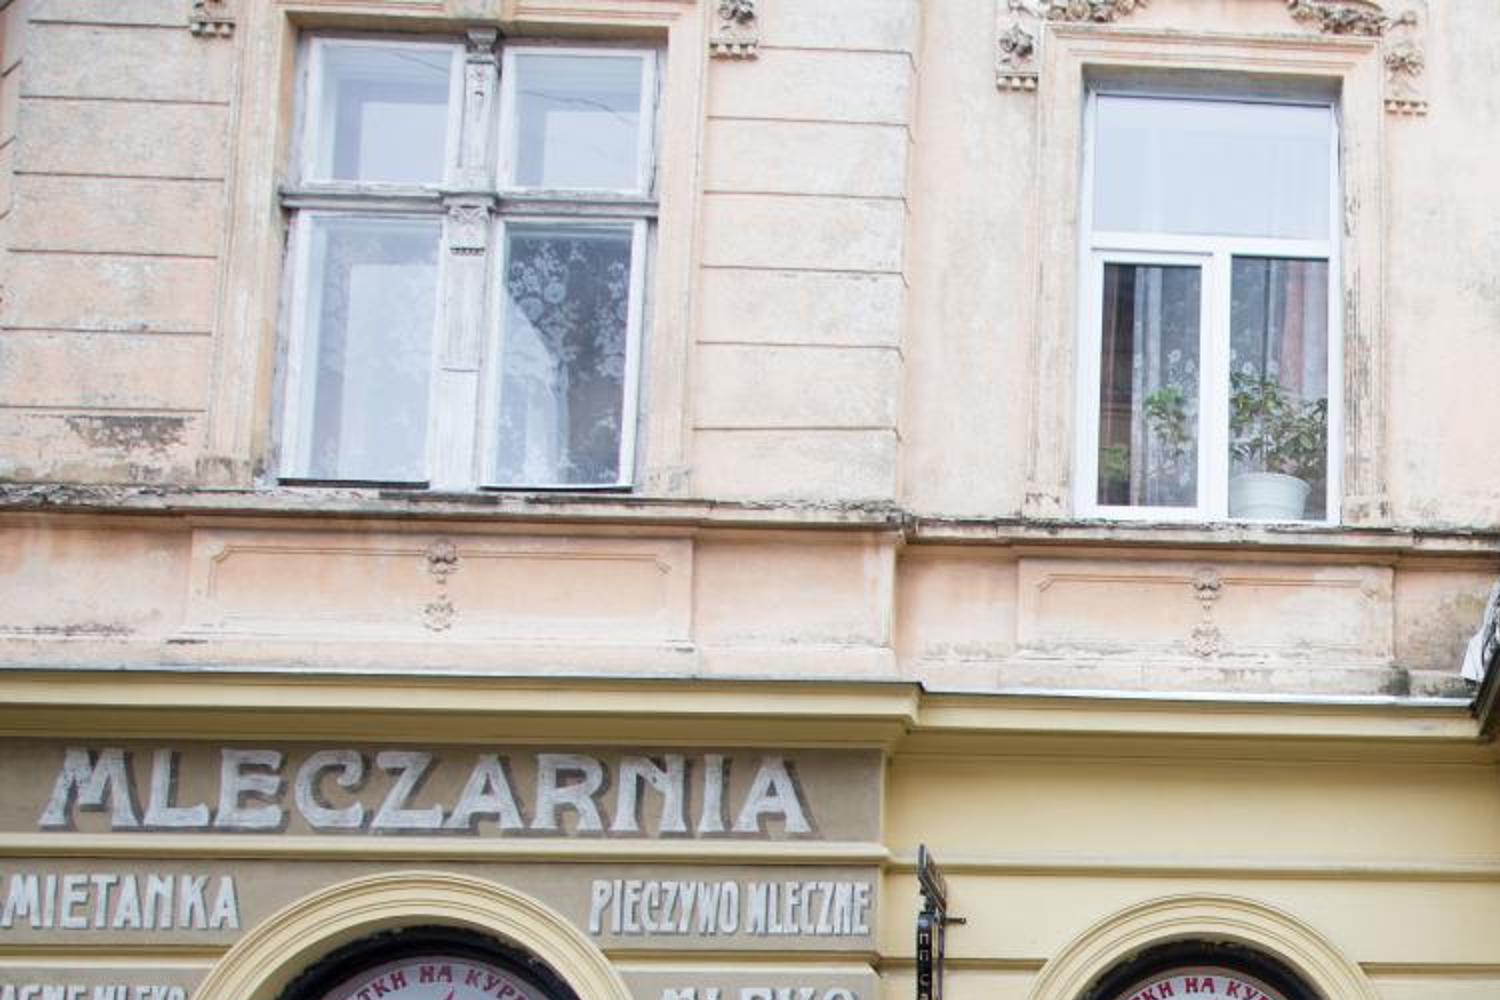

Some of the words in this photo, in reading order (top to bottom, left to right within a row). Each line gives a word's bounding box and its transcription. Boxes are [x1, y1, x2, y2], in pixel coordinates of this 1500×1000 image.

[38, 749, 812, 834] MLECZARNIA
[588, 879, 740, 936] PIECZYWO
[746, 881, 872, 936] MLECZNE
[419, 965, 453, 984] НА
[1184, 977, 1216, 993] НА
